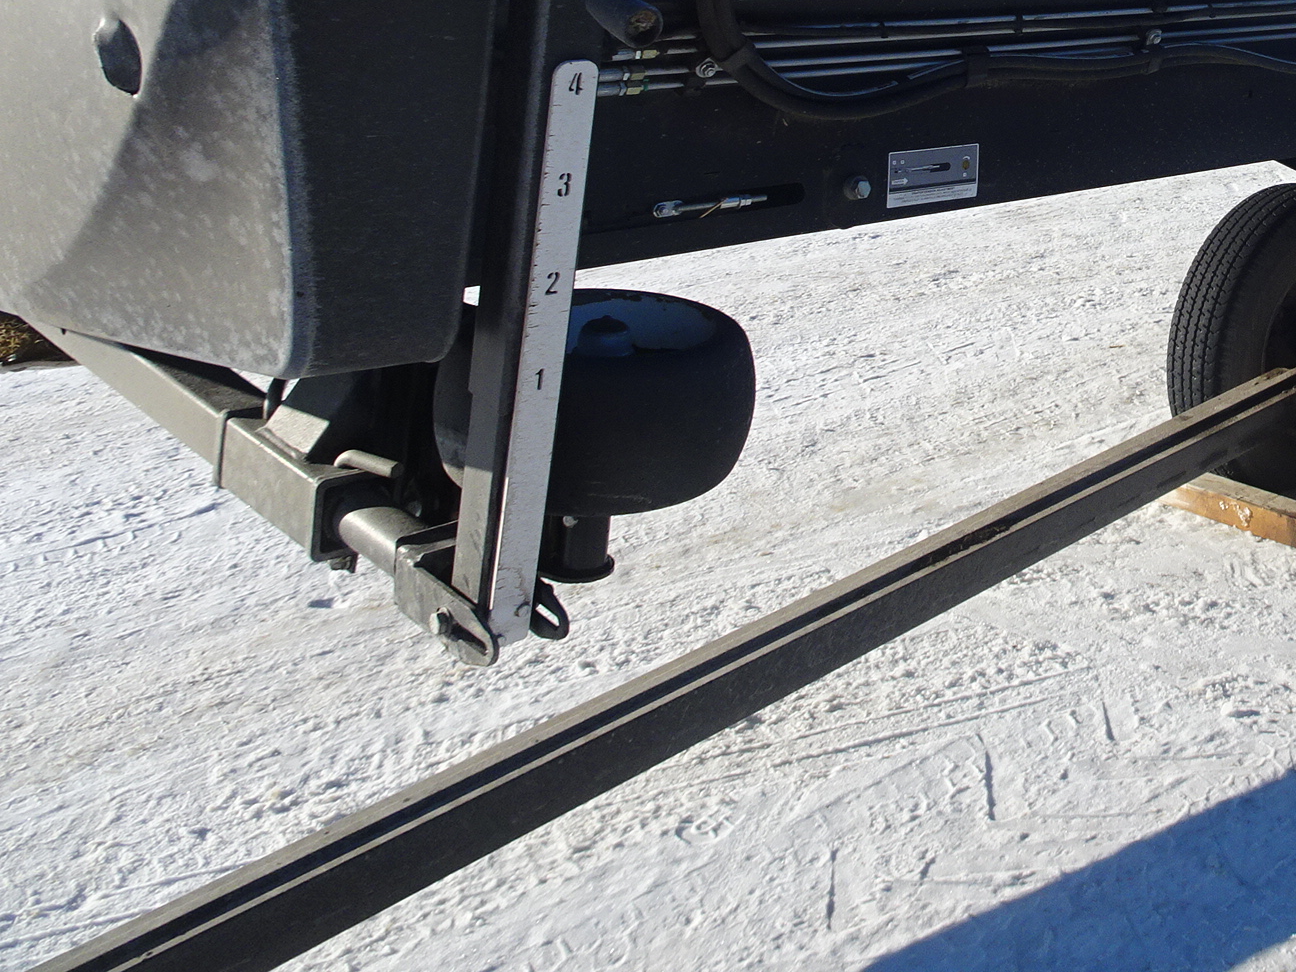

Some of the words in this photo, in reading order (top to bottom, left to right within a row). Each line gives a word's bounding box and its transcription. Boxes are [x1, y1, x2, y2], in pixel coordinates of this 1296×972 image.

[568, 72, 583, 96] 4
[557, 172, 572, 197] 3
[545, 271, 560, 296] 2
[535, 368, 545, 391] 1
